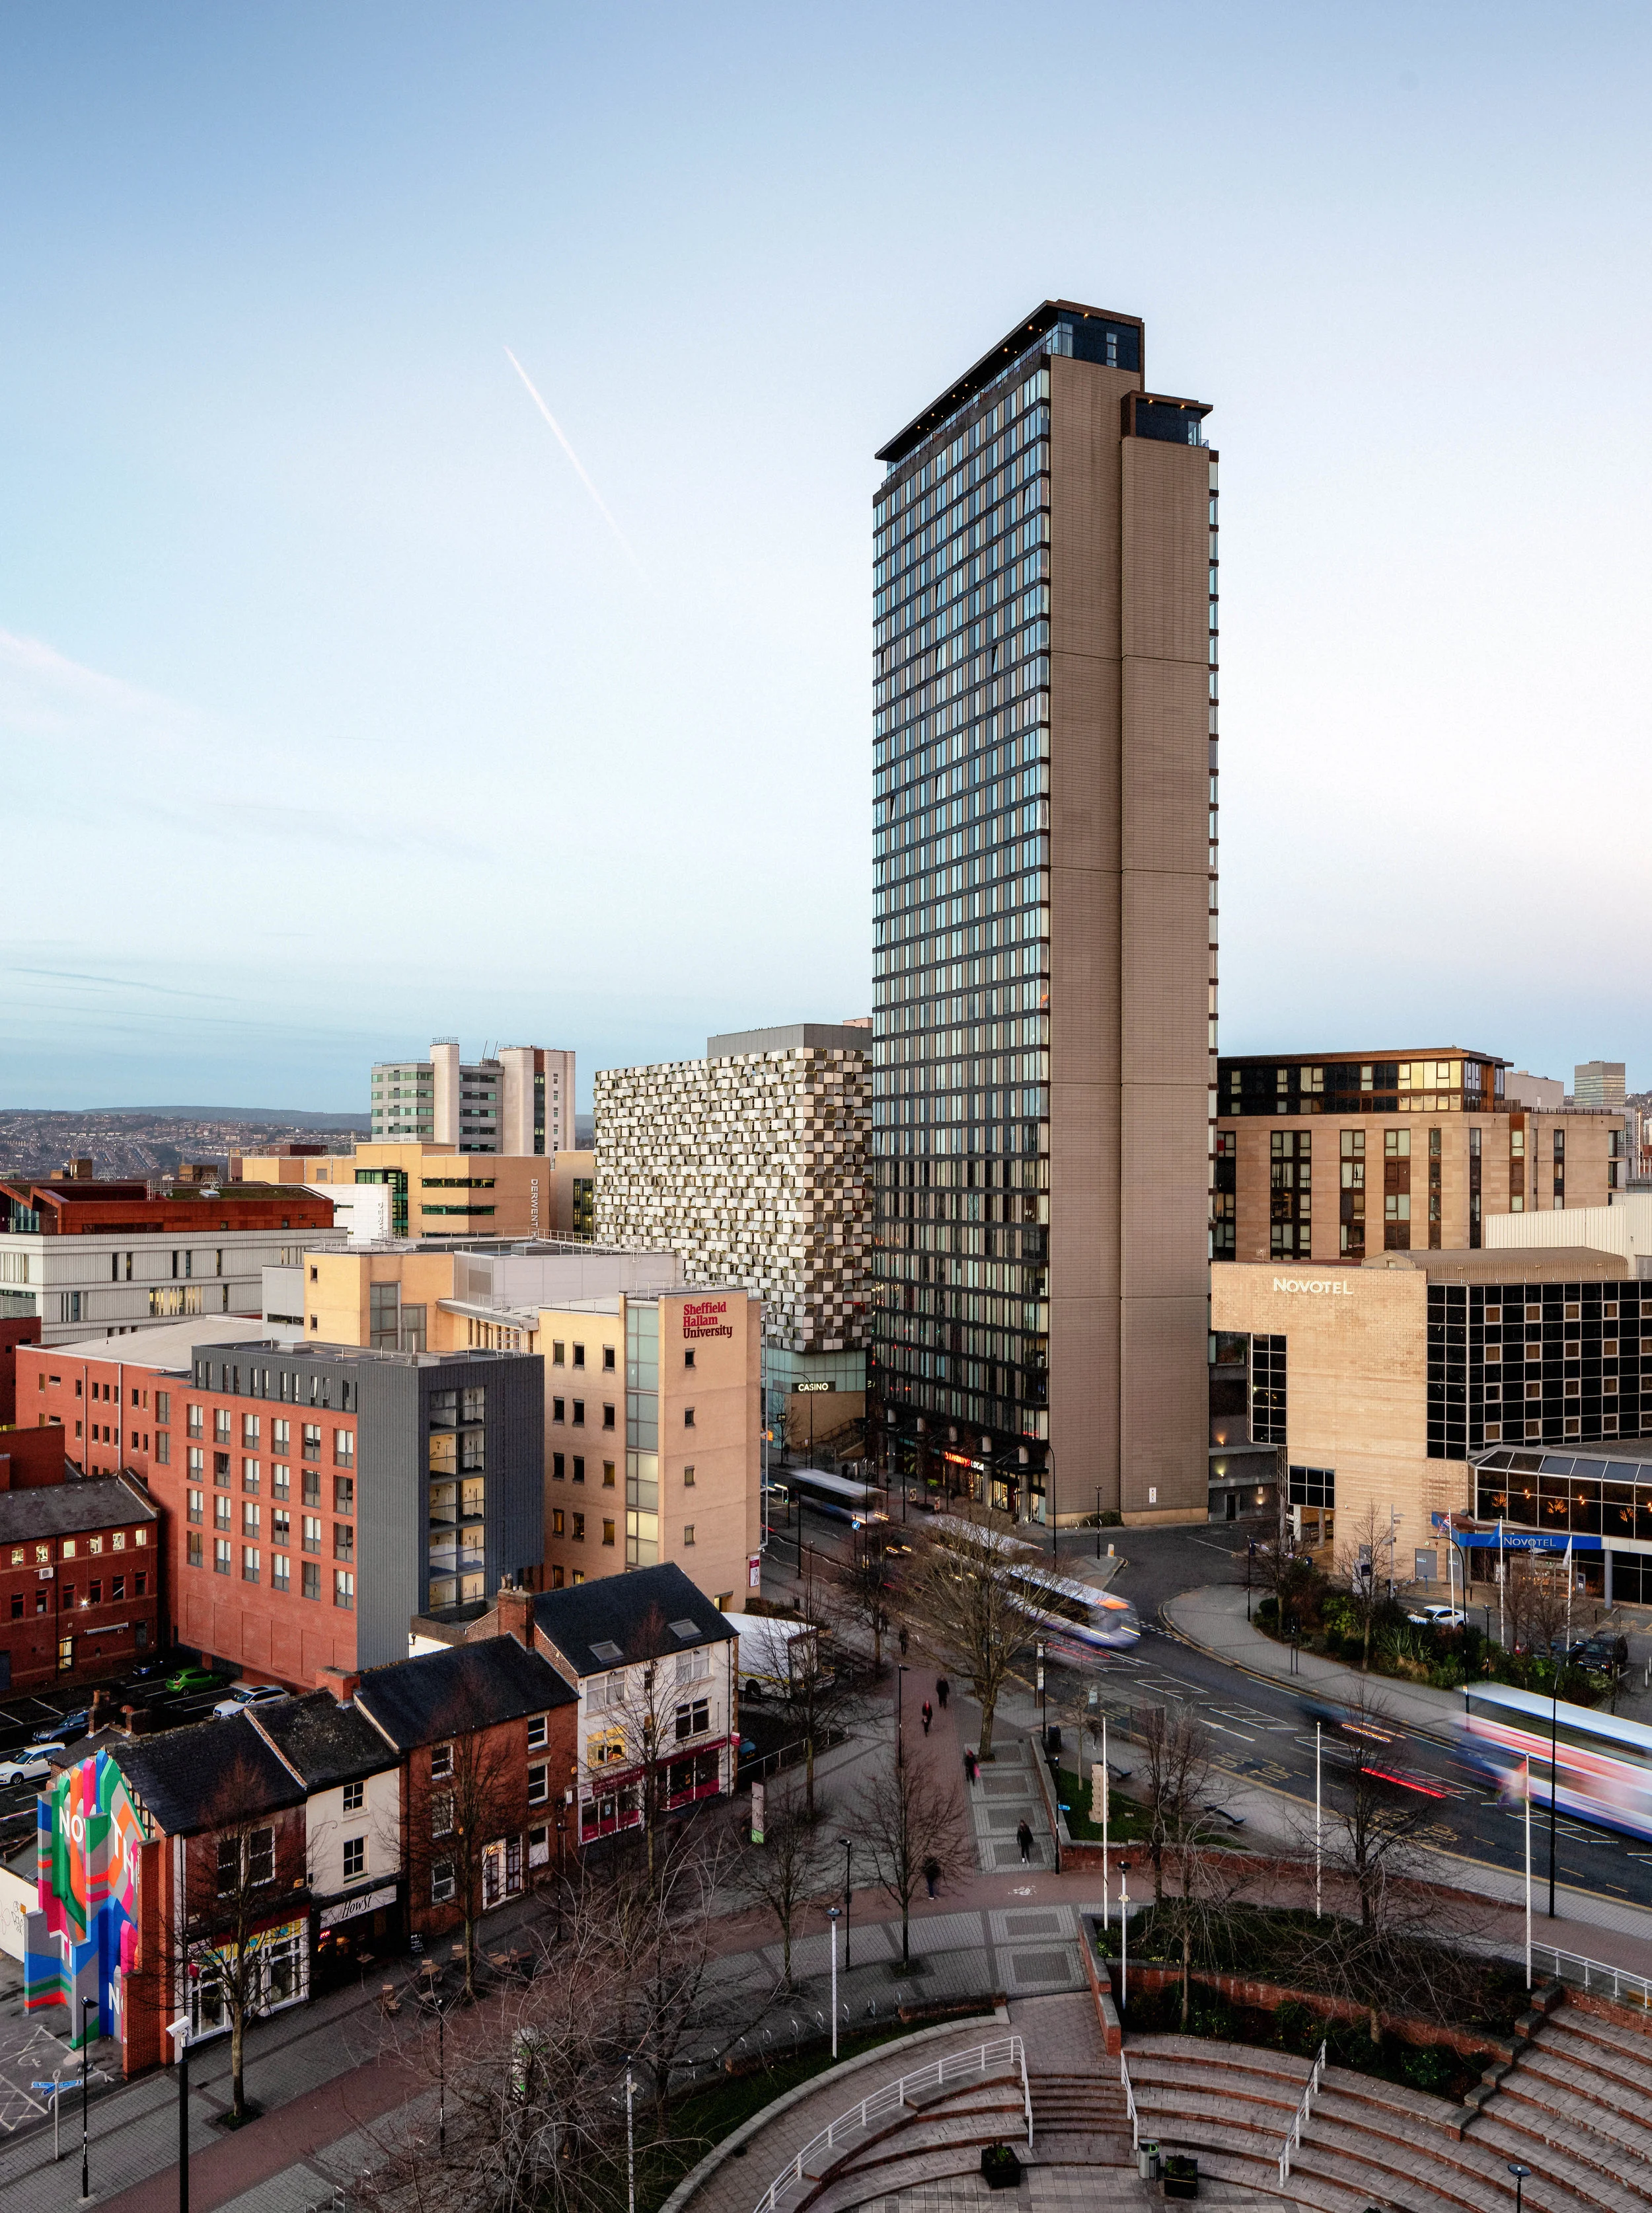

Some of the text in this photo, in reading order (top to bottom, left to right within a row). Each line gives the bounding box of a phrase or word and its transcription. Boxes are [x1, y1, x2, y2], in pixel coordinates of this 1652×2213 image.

[1273, 1276, 1353, 1295] NOVOTEL
[683, 1301, 726, 1315] Sheffield
[683, 1315, 718, 1327] Hallam
[683, 1325, 733, 1339] University
[798, 1382, 829, 1391] CASINO
[1503, 1537, 1556, 1547] NOVOTEL
[1216, 1752, 1253, 1769] BUS
[1245, 1764, 1293, 1784] STOP
[59, 1806, 86, 1843] NO
[111, 1810, 137, 1894] TH
